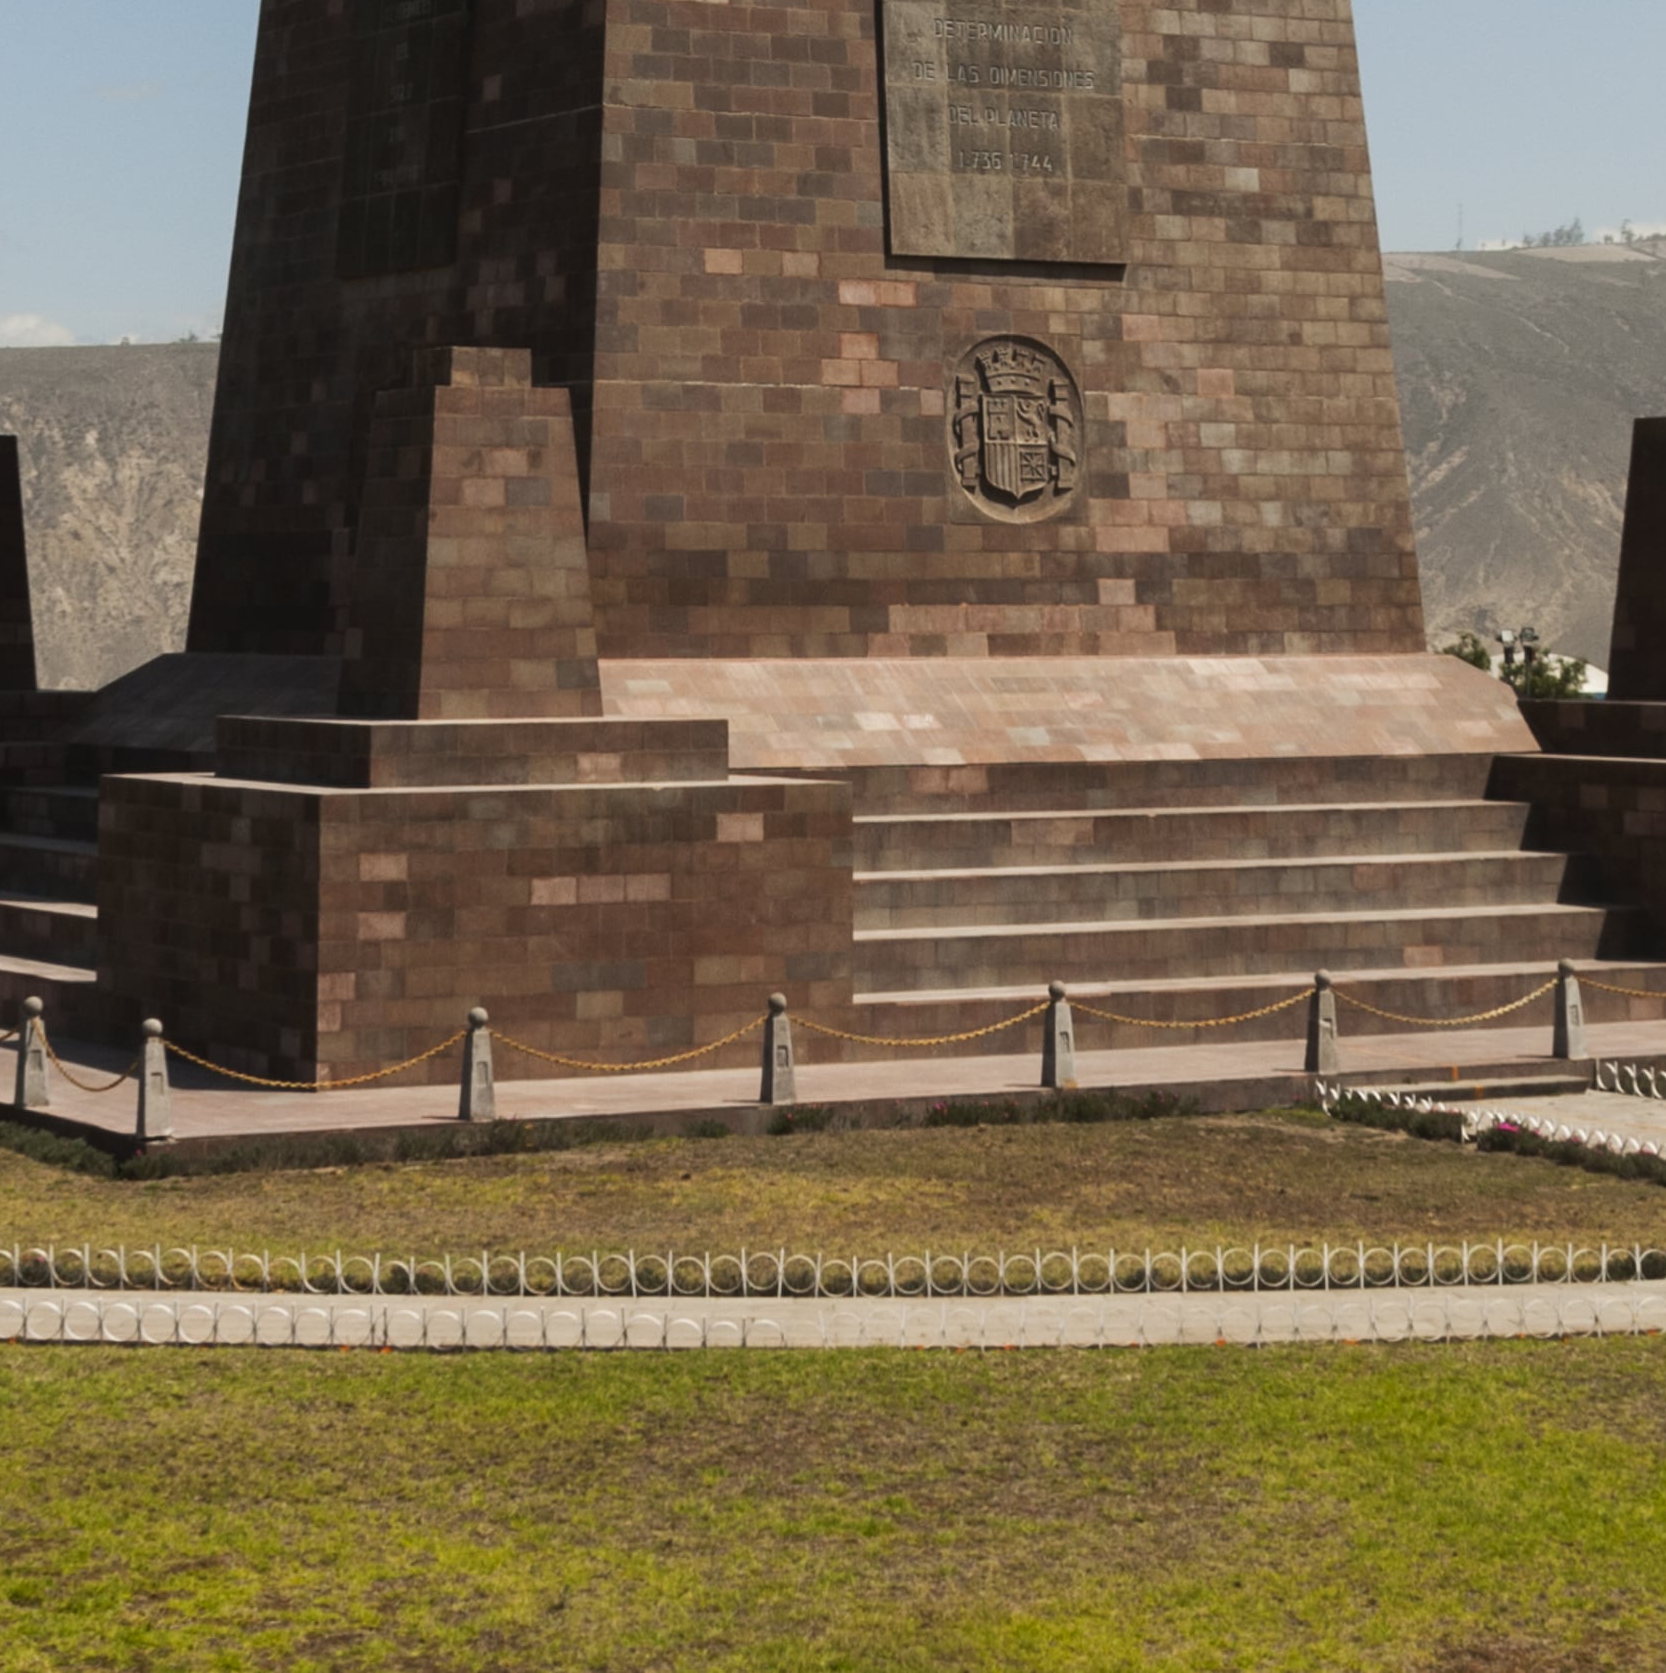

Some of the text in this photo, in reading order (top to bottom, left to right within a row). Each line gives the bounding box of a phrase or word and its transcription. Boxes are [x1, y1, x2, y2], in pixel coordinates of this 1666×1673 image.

[934, 18, 1072, 45] DETERMINACION
[913, 61, 1094, 90] DE LAS DIMENSIONES
[949, 105, 1060, 131] DEL PLANETA
